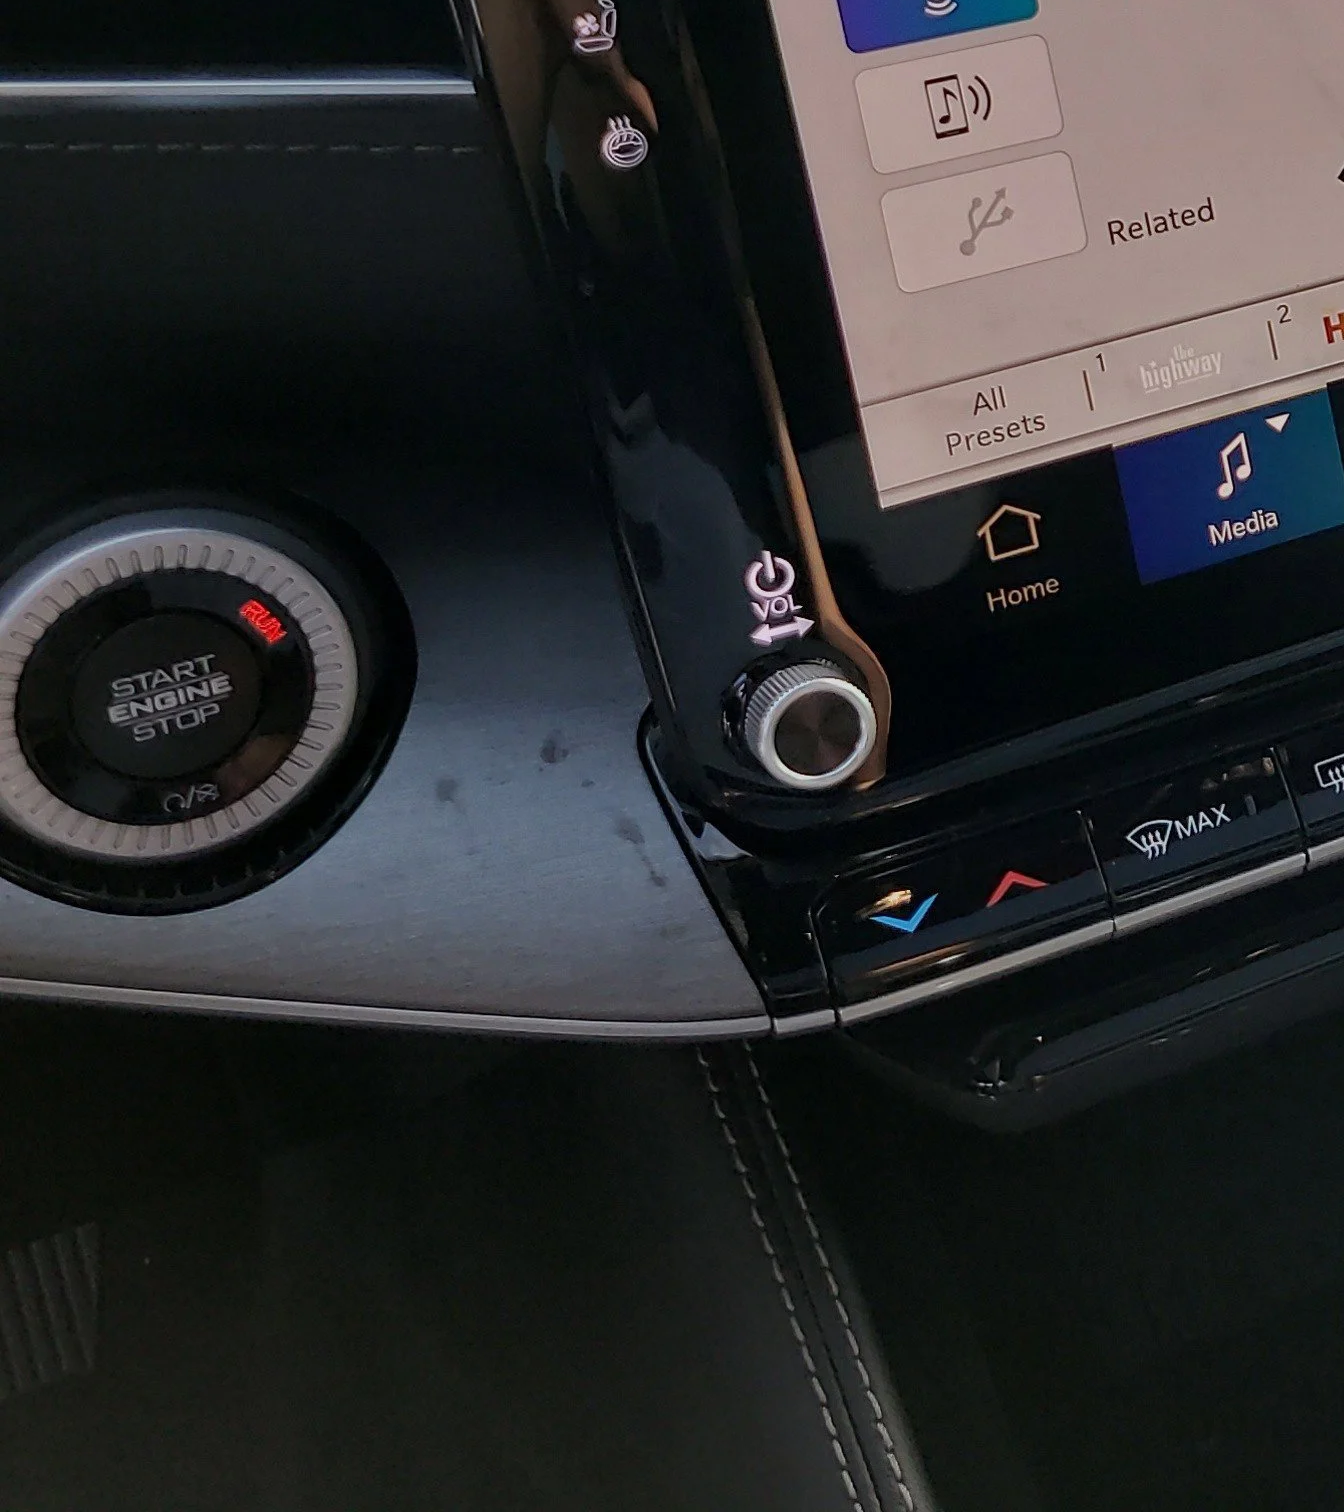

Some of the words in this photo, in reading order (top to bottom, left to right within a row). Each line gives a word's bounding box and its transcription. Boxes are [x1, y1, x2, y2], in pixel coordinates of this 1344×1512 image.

[1107, 198, 1216, 246] Related
[1277, 304, 1292, 324] 2
[1096, 353, 1107, 372] 1
[1140, 352, 1222, 390] highway
[972, 386, 1007, 415] All
[945, 411, 1047, 456] Presets
[1207, 508, 1280, 546] Media
[749, 593, 803, 622] VOL
[986, 575, 1060, 613] Home
[111, 653, 216, 698] START
[107, 672, 234, 725] ENGINE
[133, 703, 221, 743] STOP
[1173, 803, 1232, 841] MAX
